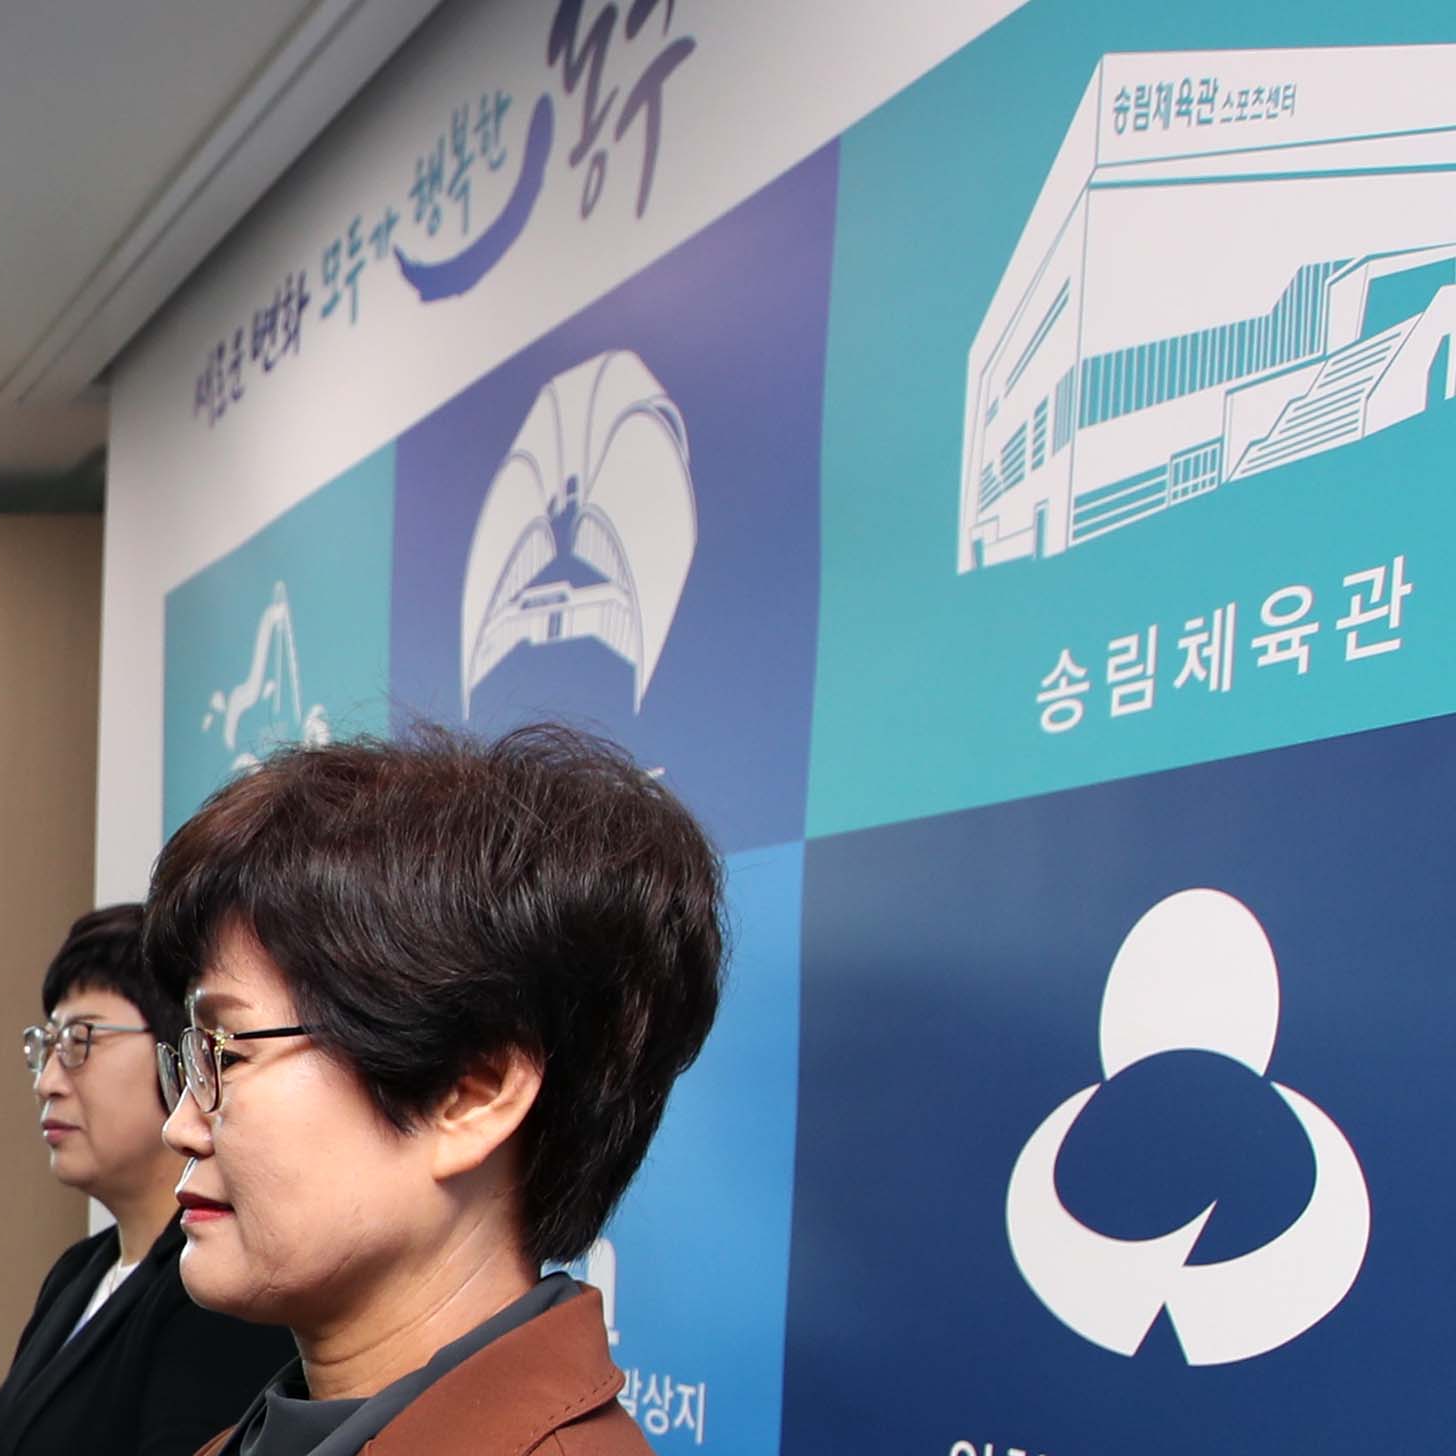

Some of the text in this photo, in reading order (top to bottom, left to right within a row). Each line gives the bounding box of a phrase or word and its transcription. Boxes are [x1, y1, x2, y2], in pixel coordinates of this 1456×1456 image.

[1114, 77, 1297, 135] 송림체육관 스포츠센터
[251, 270, 310, 373] 변화
[320, 208, 399, 325] 모두가
[409, 90, 512, 237] 행복한
[1036, 554, 1413, 734] 송림체육관
